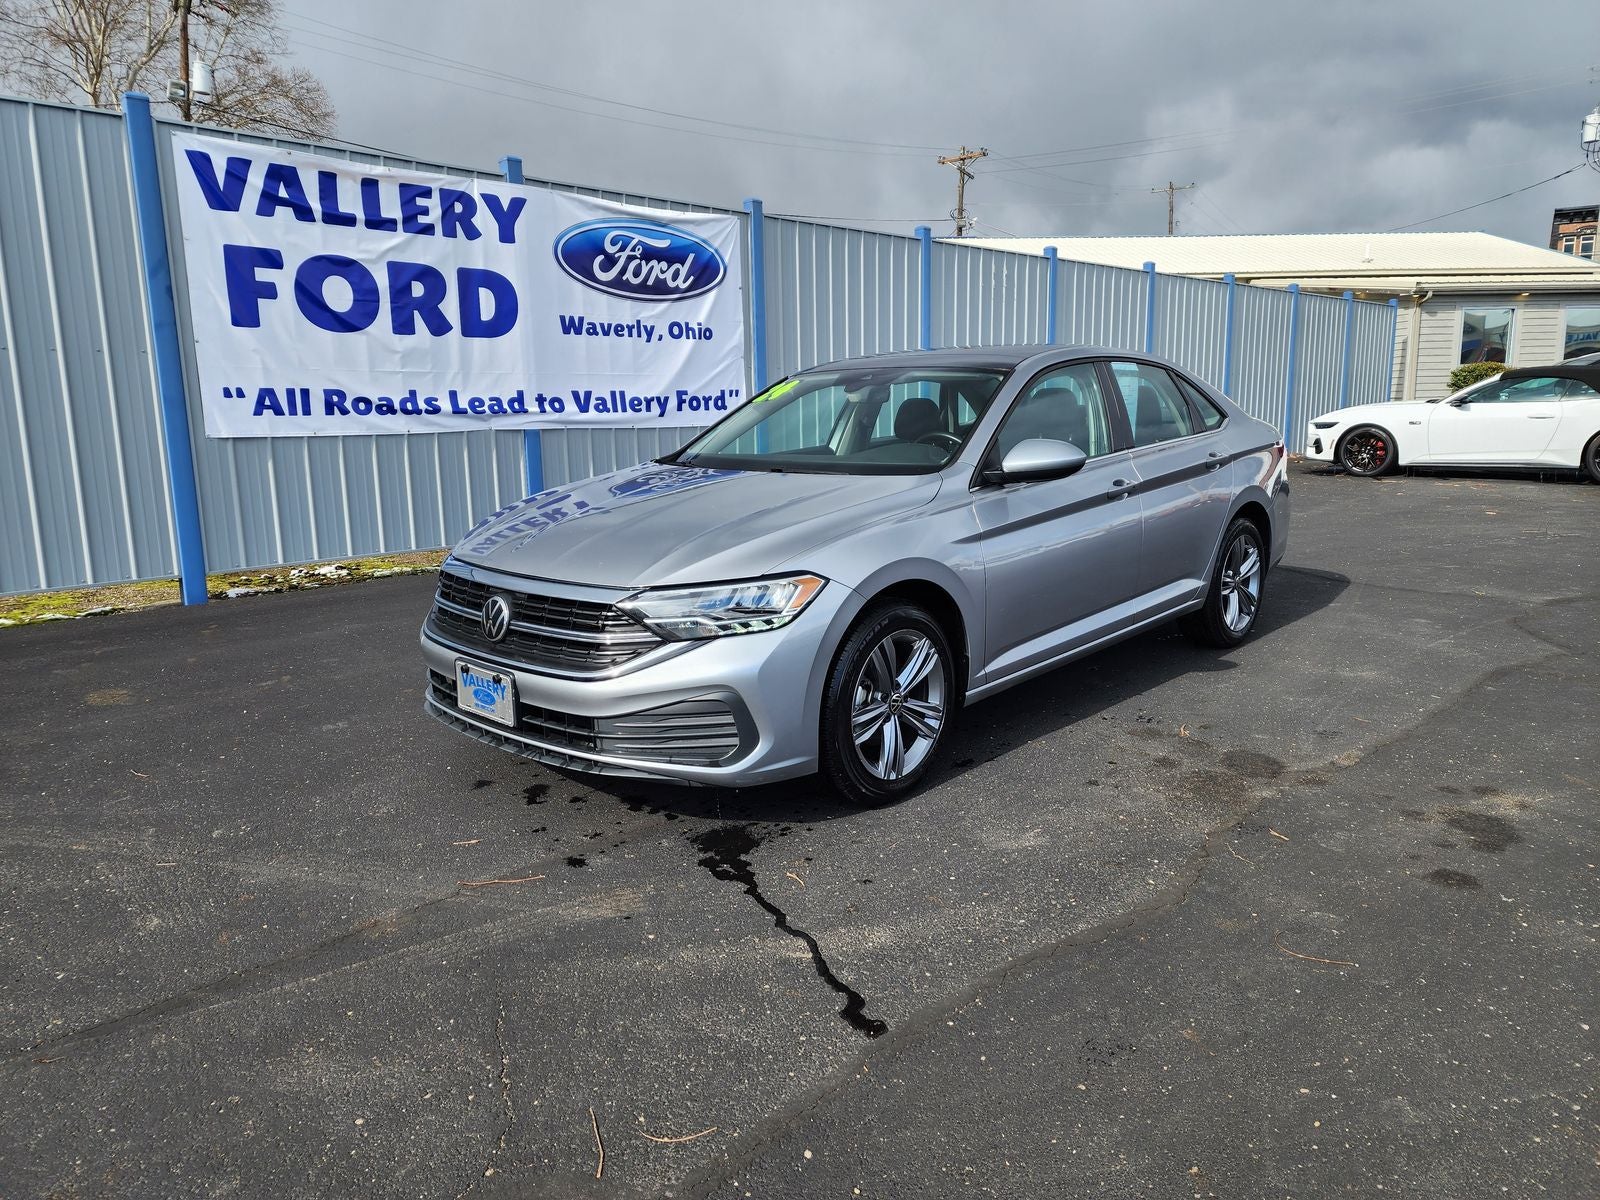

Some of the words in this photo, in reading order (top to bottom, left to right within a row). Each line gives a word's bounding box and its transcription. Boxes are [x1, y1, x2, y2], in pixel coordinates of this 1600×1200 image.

[184, 149, 527, 244] VALLERY
[592, 230, 696, 289] Ford
[223, 244, 519, 338] FORD
[559, 314, 664, 343] Waverly,
[667, 321, 713, 341] Ohio
[322, 388, 442, 416] Roads
[448, 389, 529, 415] Lead
[534, 393, 566, 414] to
[570, 390, 670, 418] Vallery
[461, 670, 507, 701] VALLERY
